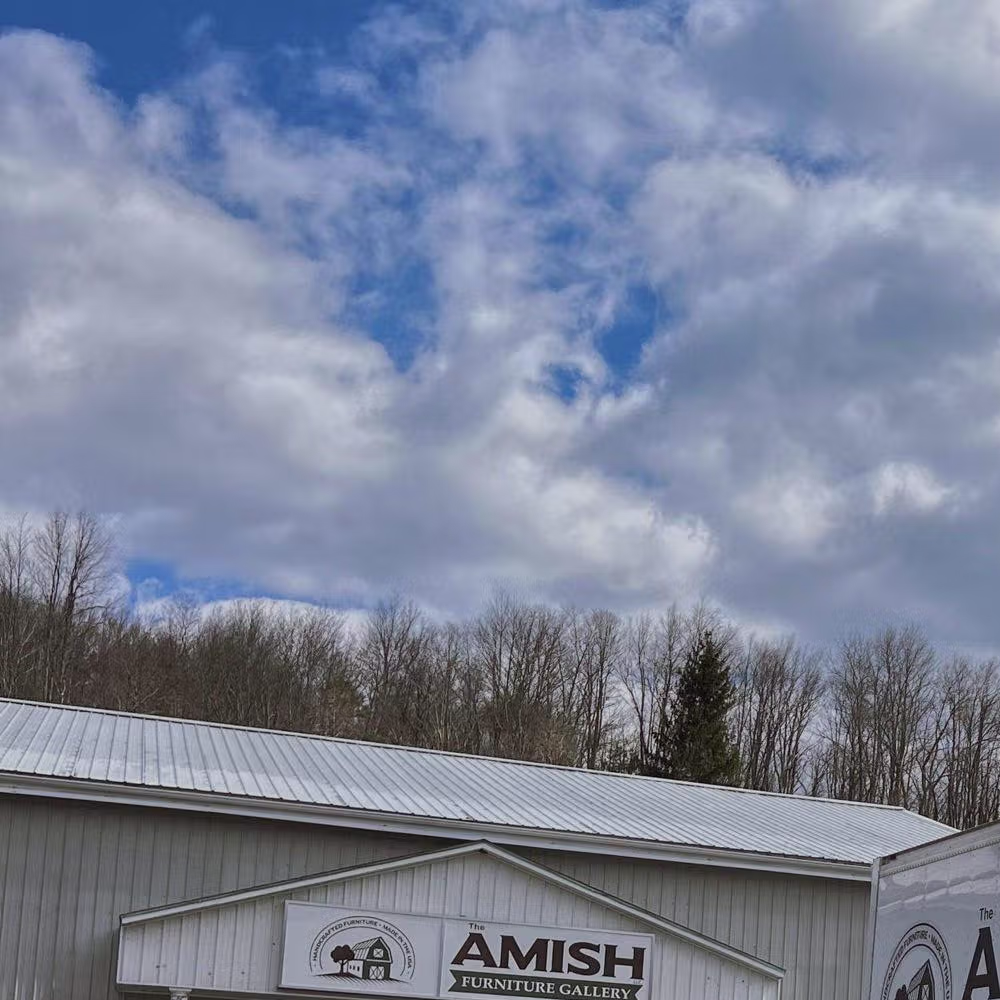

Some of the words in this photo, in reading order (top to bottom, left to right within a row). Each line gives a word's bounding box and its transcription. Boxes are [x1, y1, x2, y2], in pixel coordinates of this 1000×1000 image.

[979, 907, 994, 921] The
[468, 922, 485, 931] The
[312, 922, 343, 962] HANDCRAFTED
[343, 919, 379, 927] FURNITURE
[383, 924, 398, 937] MADE
[402, 942, 411, 954] THE
[450, 932, 646, 980] AMISH
[461, 976, 555, 994] FURNITURE
[559, 984, 632, 1000] GALLERY
